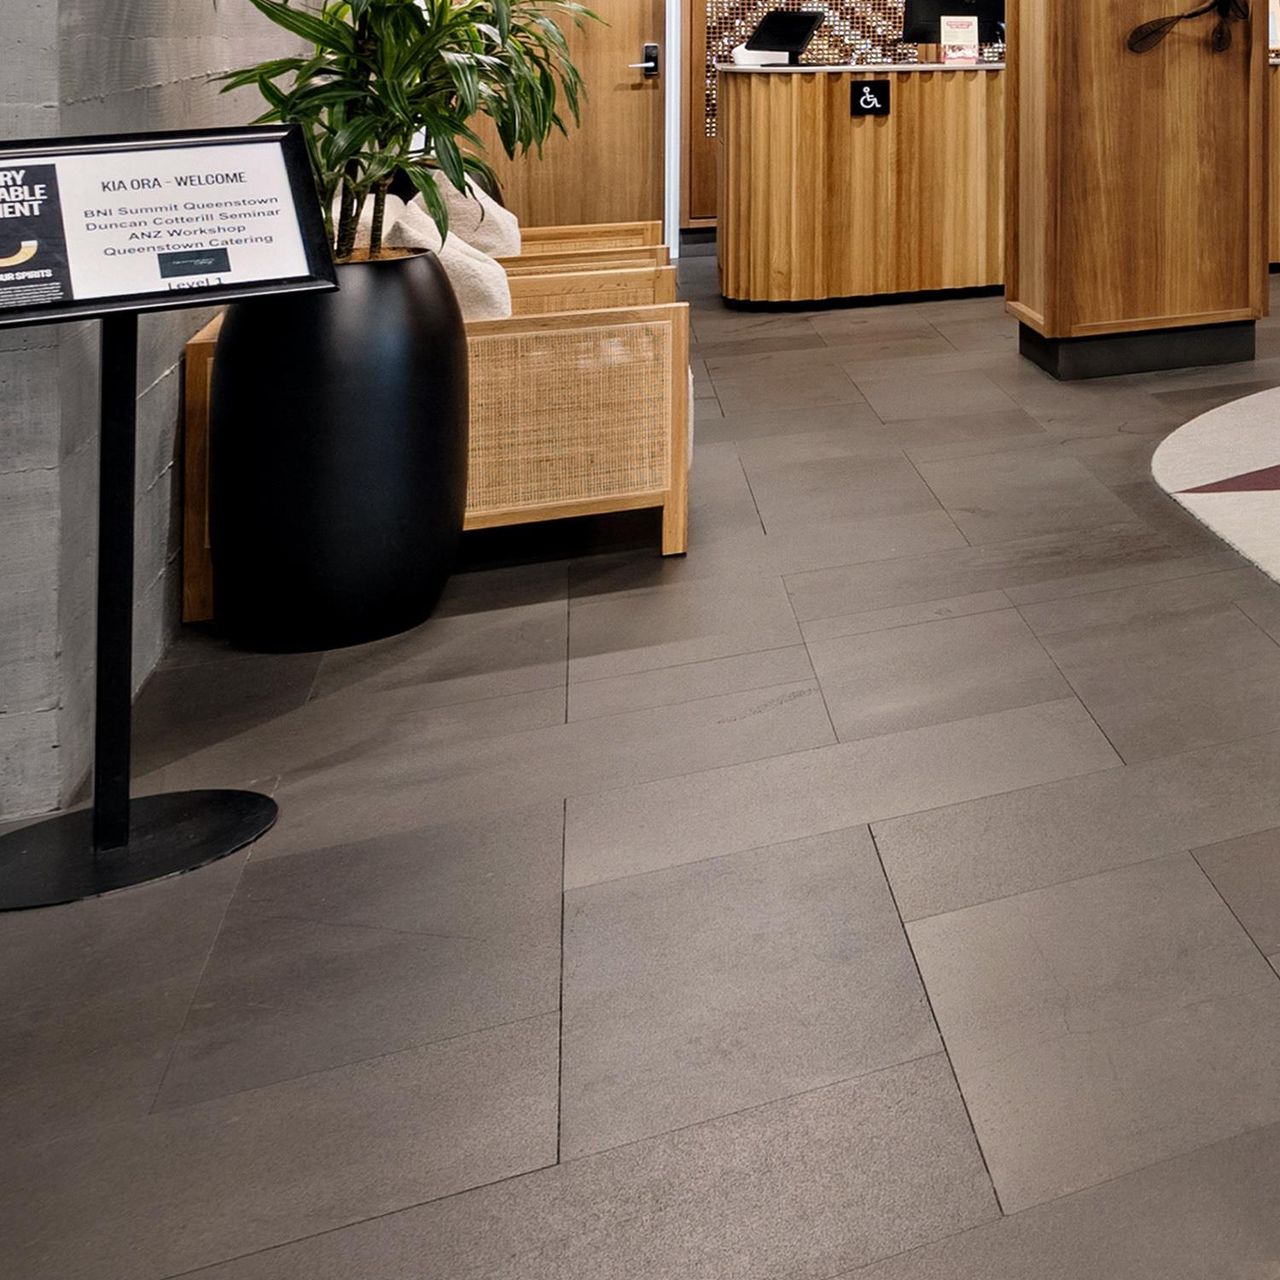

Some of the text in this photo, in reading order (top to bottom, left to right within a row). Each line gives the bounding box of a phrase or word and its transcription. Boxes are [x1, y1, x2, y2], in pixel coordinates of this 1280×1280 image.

[101, 180, 128, 192] KIA
[130, 178, 162, 190] ORA
[174, 172, 248, 187] WELCOME
[0, 184, 48, 201] ABLE
[0, 200, 43, 218] ENT
[84, 197, 278, 218] BNI Summit Queenstown
[86, 208, 281, 231] Duncan Cotterill Seminar
[129, 225, 246, 240] ANZ Workshop
[103, 235, 273, 256] Queenstown Catering
